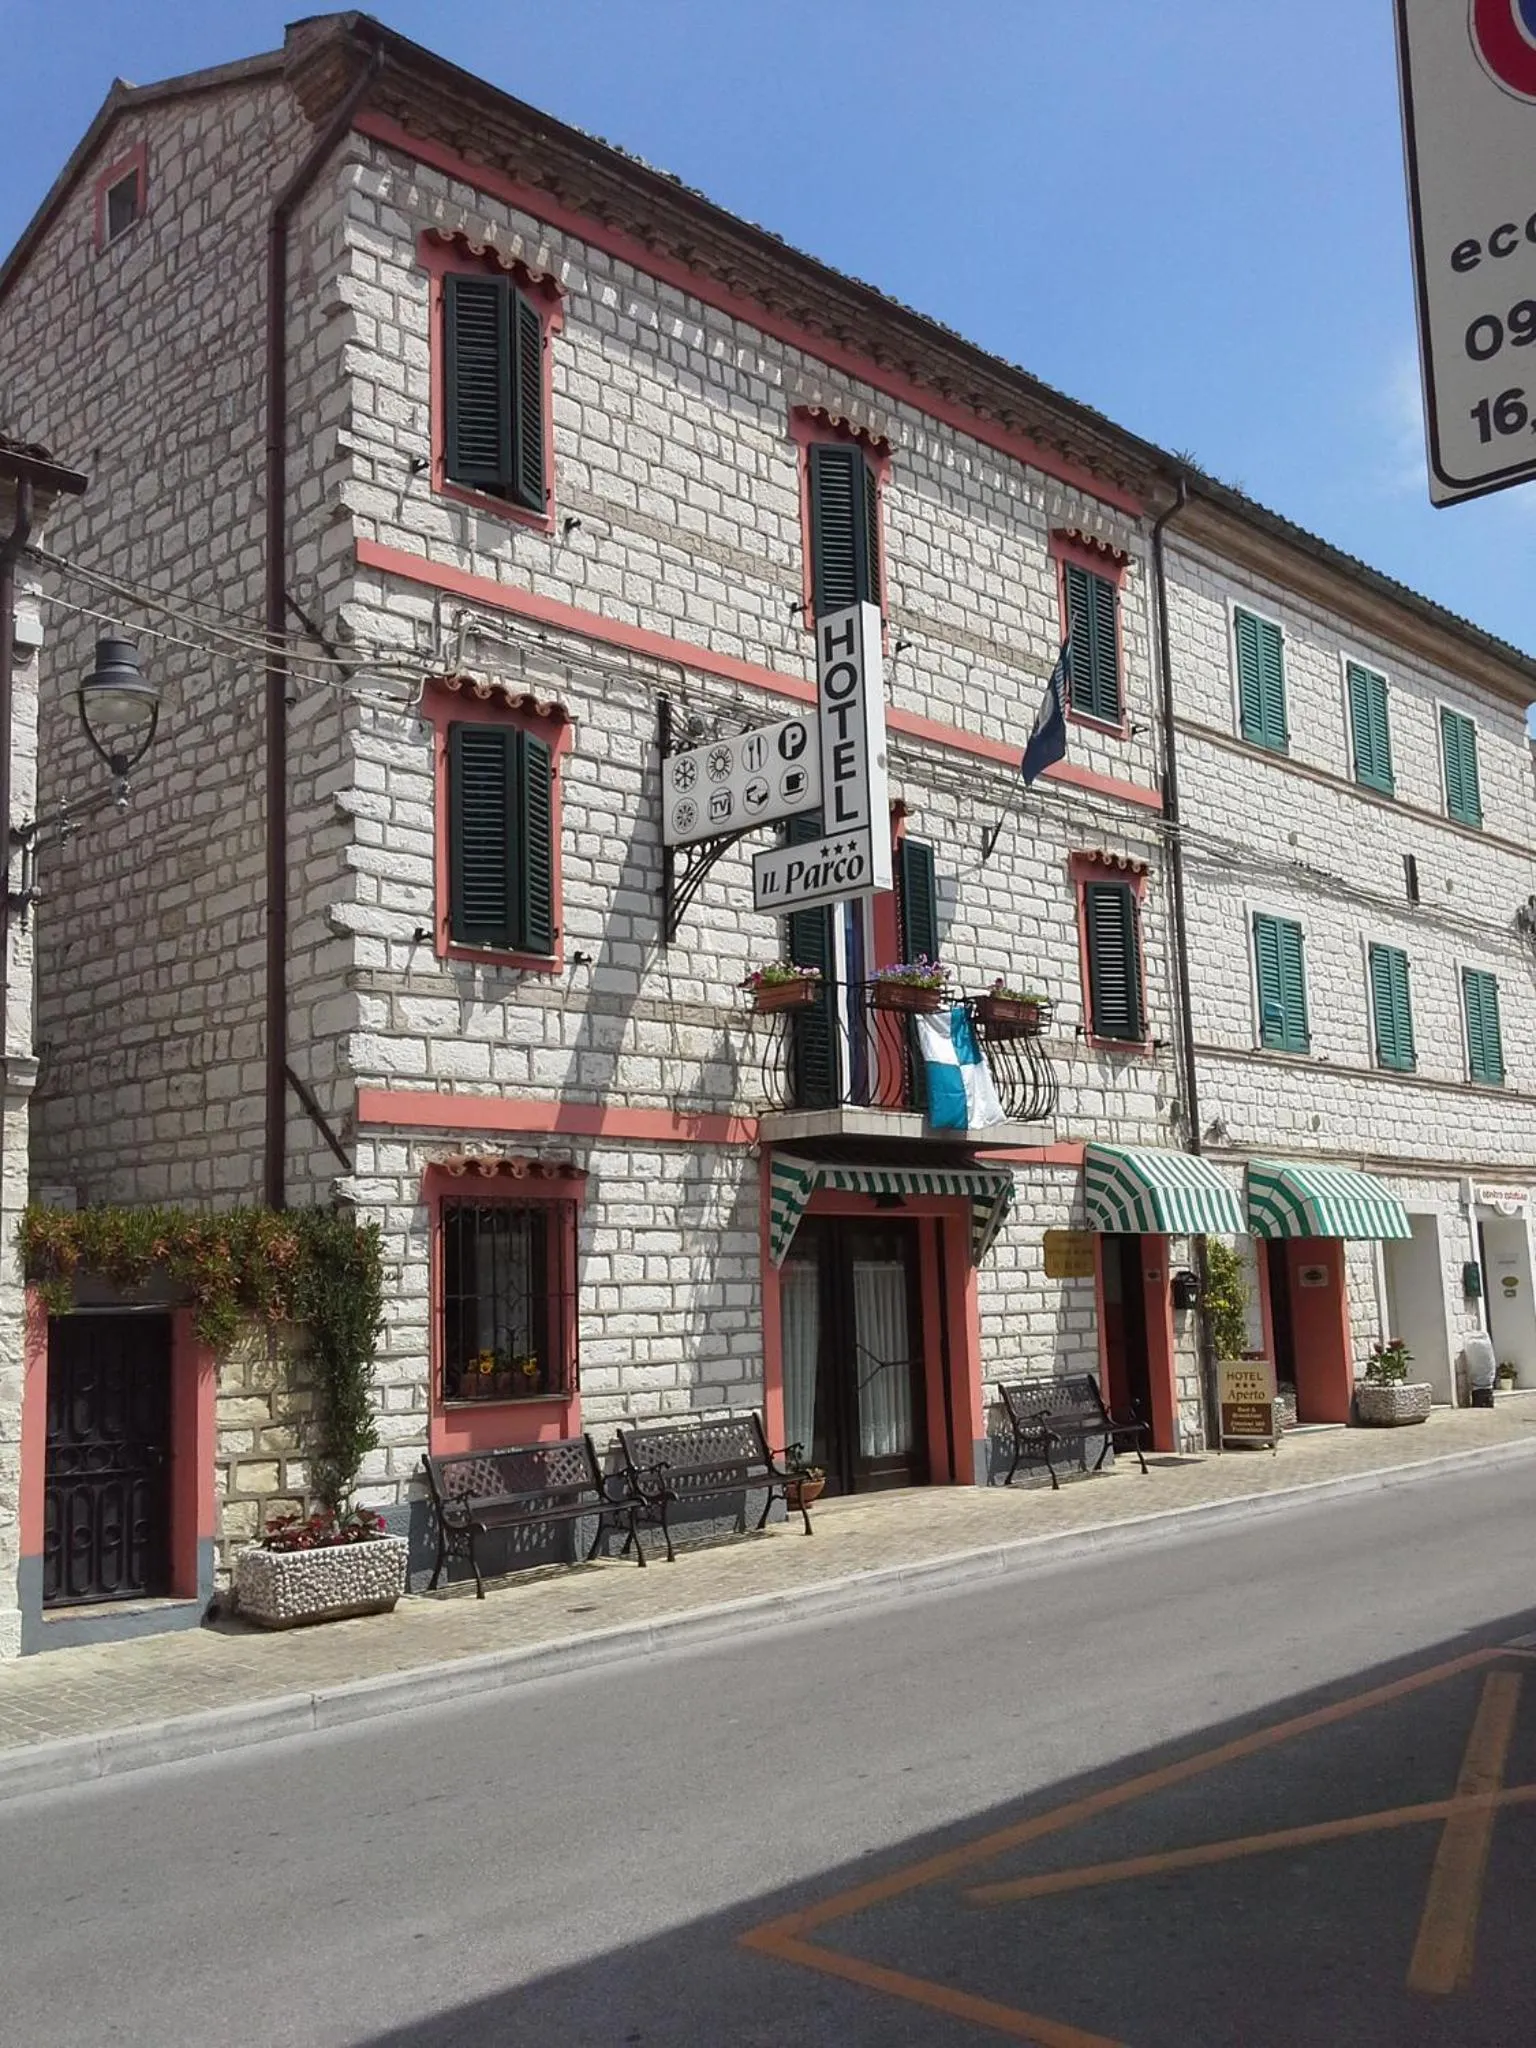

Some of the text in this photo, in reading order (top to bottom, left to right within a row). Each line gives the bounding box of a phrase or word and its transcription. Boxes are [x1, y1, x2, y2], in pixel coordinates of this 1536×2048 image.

[824, 618, 859, 823] HOTEL
[784, 725, 804, 758] P
[711, 799, 728, 814] TV
[761, 855, 864, 895] IL Parco
[1226, 1371, 1264, 1381] HOTEL
[1228, 1389, 1266, 1402] Aperto
